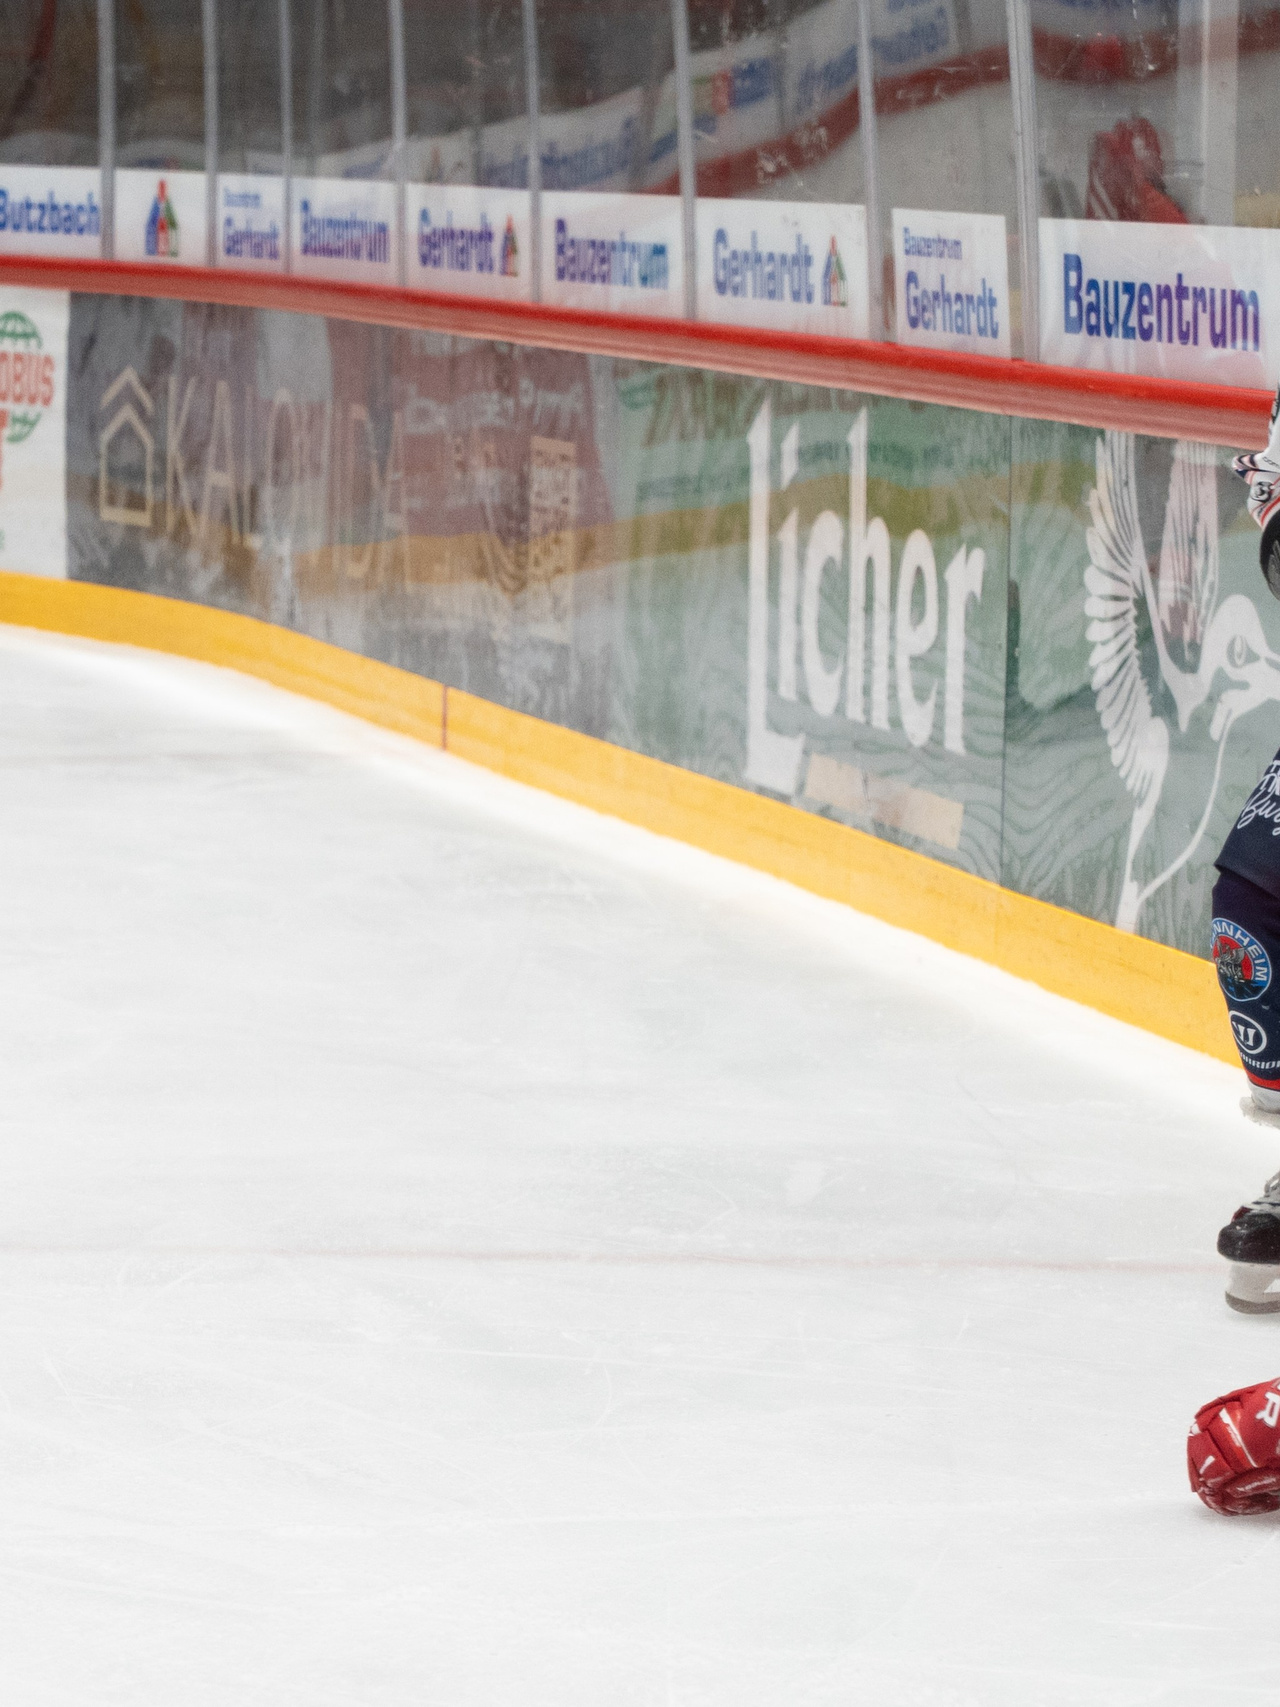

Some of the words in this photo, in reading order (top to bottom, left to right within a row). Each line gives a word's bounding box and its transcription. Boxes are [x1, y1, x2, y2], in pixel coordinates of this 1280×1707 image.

[555, 217, 669, 290] Bauzentrum
[712, 227, 815, 305] Gerhardt
[902, 227, 962, 262] Bauzentrum
[905, 271, 999, 340] Gerhardt
[1063, 253, 1260, 352] Bauzentrum
[746, 397, 986, 796] Licher
